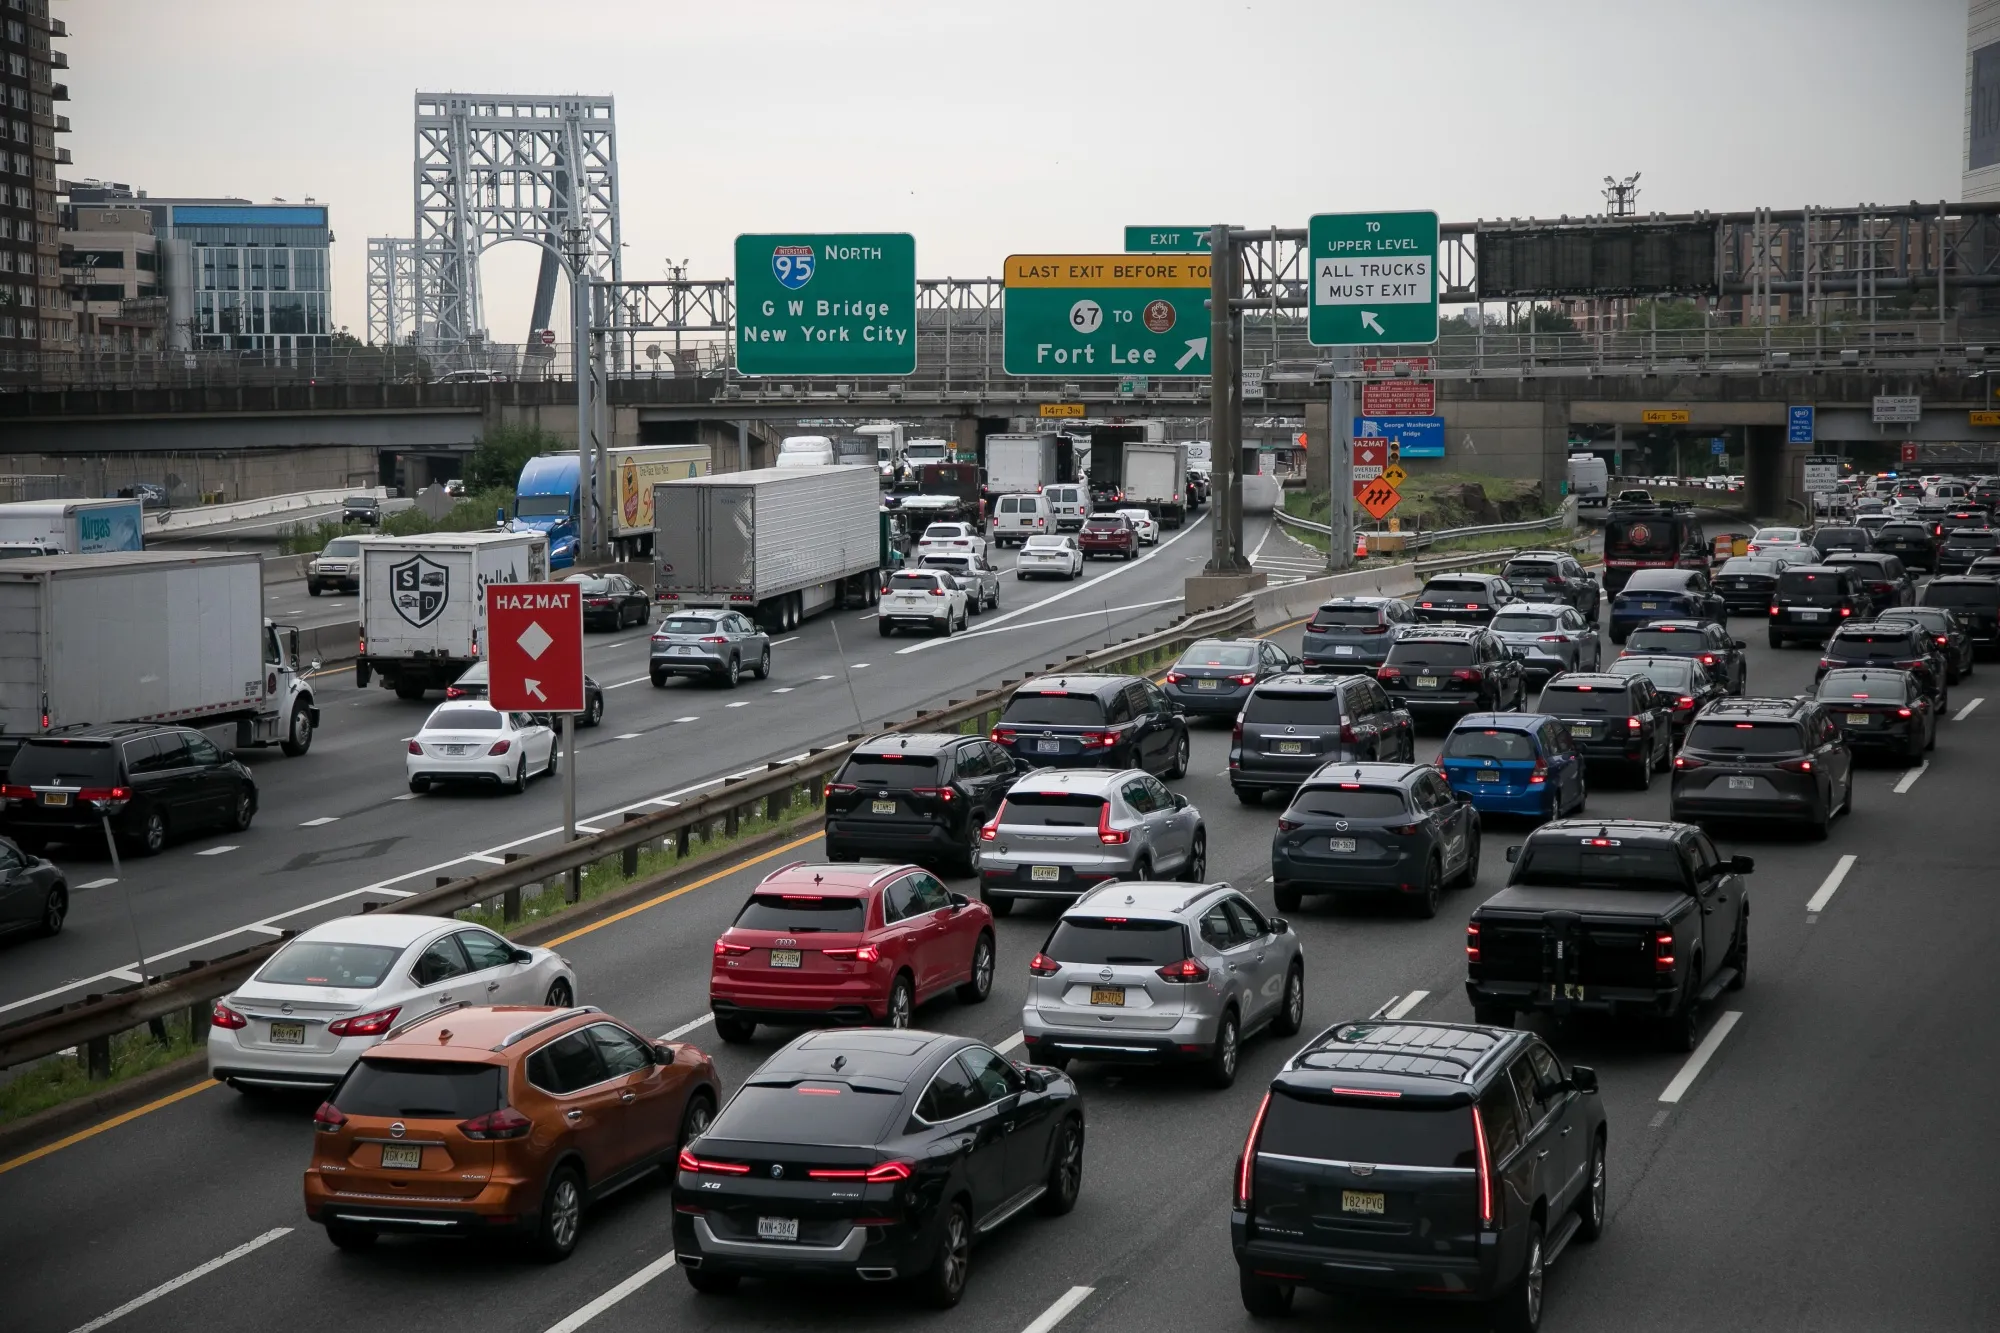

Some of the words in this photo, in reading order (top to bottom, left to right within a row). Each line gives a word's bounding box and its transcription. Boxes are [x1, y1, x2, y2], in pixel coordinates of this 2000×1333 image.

[1366, 222, 1380, 233] TO
[1150, 234, 1180, 245] EXIT
[1328, 240, 1372, 251] UPPER
[1377, 239, 1418, 250] LEVEL
[825, 245, 882, 260] NORTH
[776, 256, 811, 281] 95
[1019, 265, 1060, 278] LAST
[1069, 265, 1104, 278] EXIT
[1114, 265, 1178, 278] BEFORE
[1322, 265, 1354, 278] ALL
[1360, 263, 1426, 277] TRUCKS
[1330, 285, 1375, 298] MUST
[1381, 284, 1417, 297] EXIT
[762, 300, 775, 316] G
[788, 300, 804, 316] W
[817, 300, 889, 321] Bridge
[1073, 307, 1100, 325] 67
[1113, 310, 1133, 323] TO
[744, 326, 787, 342] New
[801, 326, 850, 342] York
[863, 325, 907, 346] City
[1037, 343, 1095, 364] Fort
[1111, 343, 1157, 364] Lee
[82, 516, 111, 541] Airgas
[402, 570, 414, 587] S
[425, 597, 435, 610] D
[496, 592, 571, 610] HAZMAT
